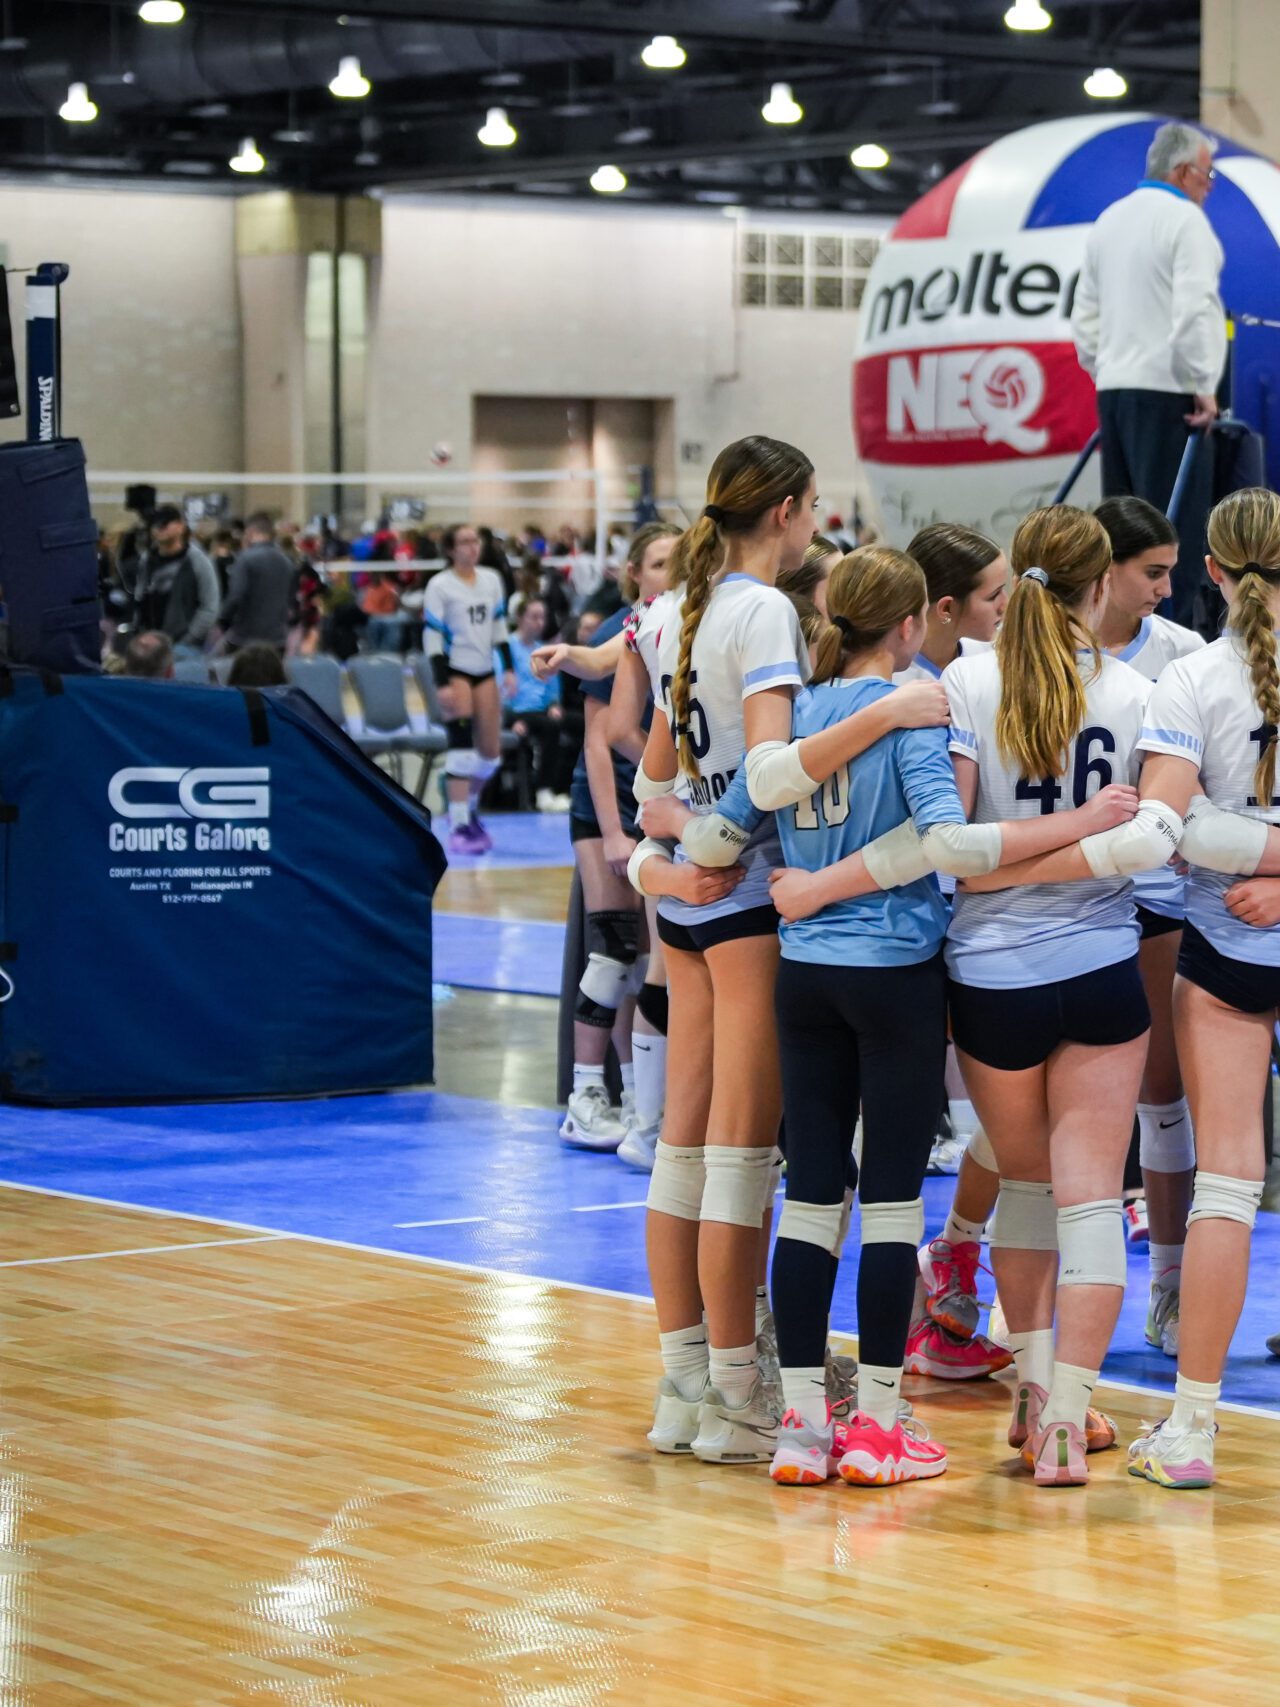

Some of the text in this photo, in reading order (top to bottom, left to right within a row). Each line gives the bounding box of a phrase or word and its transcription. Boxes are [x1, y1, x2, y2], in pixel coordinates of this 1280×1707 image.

[38, 376, 53, 441] SPALDIN
[886, 346, 1049, 453] NEQ
[108, 767, 270, 819] CG
[1015, 727, 1116, 816] 46
[109, 822, 270, 851] Courts Galore
[109, 866, 271, 878] COURTS AND FLOORING FOR ALL SPORTS
[130, 881, 253, 891] Austin TX Indianapolis IN
